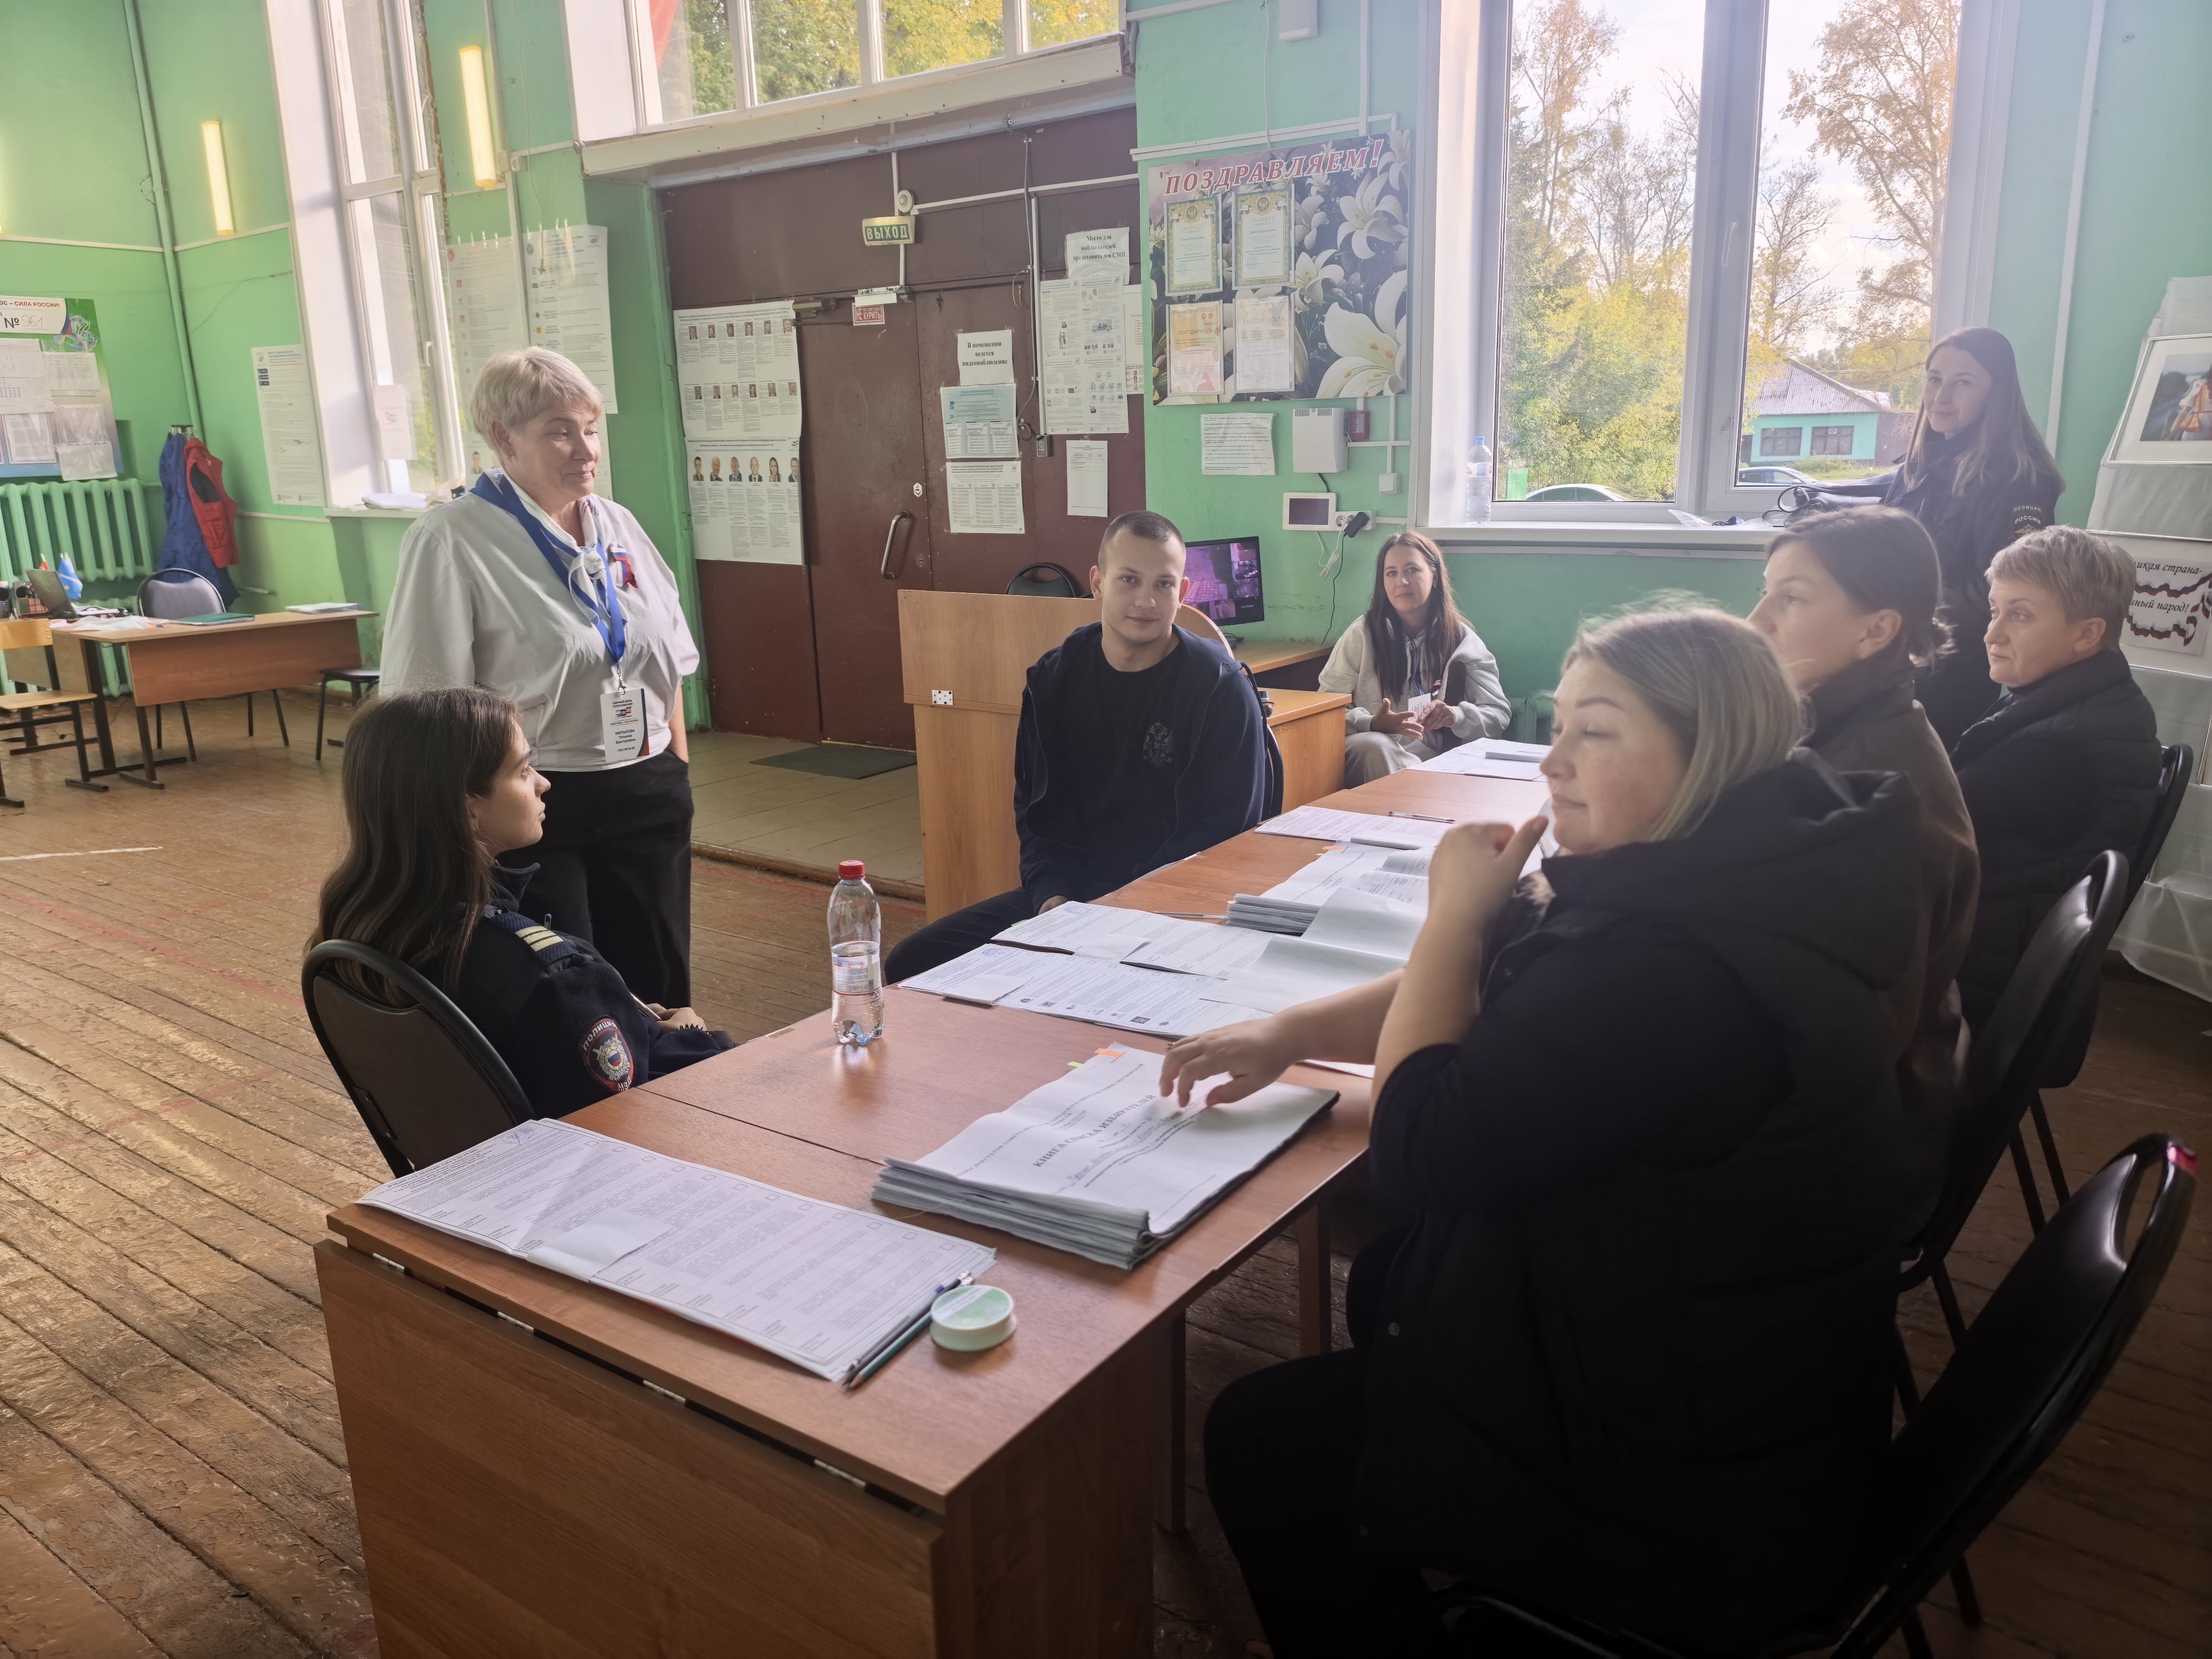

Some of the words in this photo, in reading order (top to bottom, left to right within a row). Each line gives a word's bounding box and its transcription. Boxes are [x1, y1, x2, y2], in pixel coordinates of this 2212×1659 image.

[1164, 139, 1384, 195] ПОЗДРАВЛЯЕМ!
[866, 225, 908, 240] ВЫХОД
[22, 315, 43, 327] 961
[856, 308, 862, 321] НЕ
[864, 311, 881, 320] КУРИТЬ
[2015, 515, 2041, 524] РОССИЯ
[2163, 564, 2202, 575] страна-
[2157, 602, 2189, 613] народ!
[583, 1021, 618, 1051] ПОЛИЦИЯ
[617, 1076, 632, 1091] МВД
[1033, 1142, 1067, 1167] КНИГА
[1065, 1129, 1102, 1143] СПИСКА
[1099, 1094, 1156, 1129] ИЗБИРАТЕЛЕЙ
